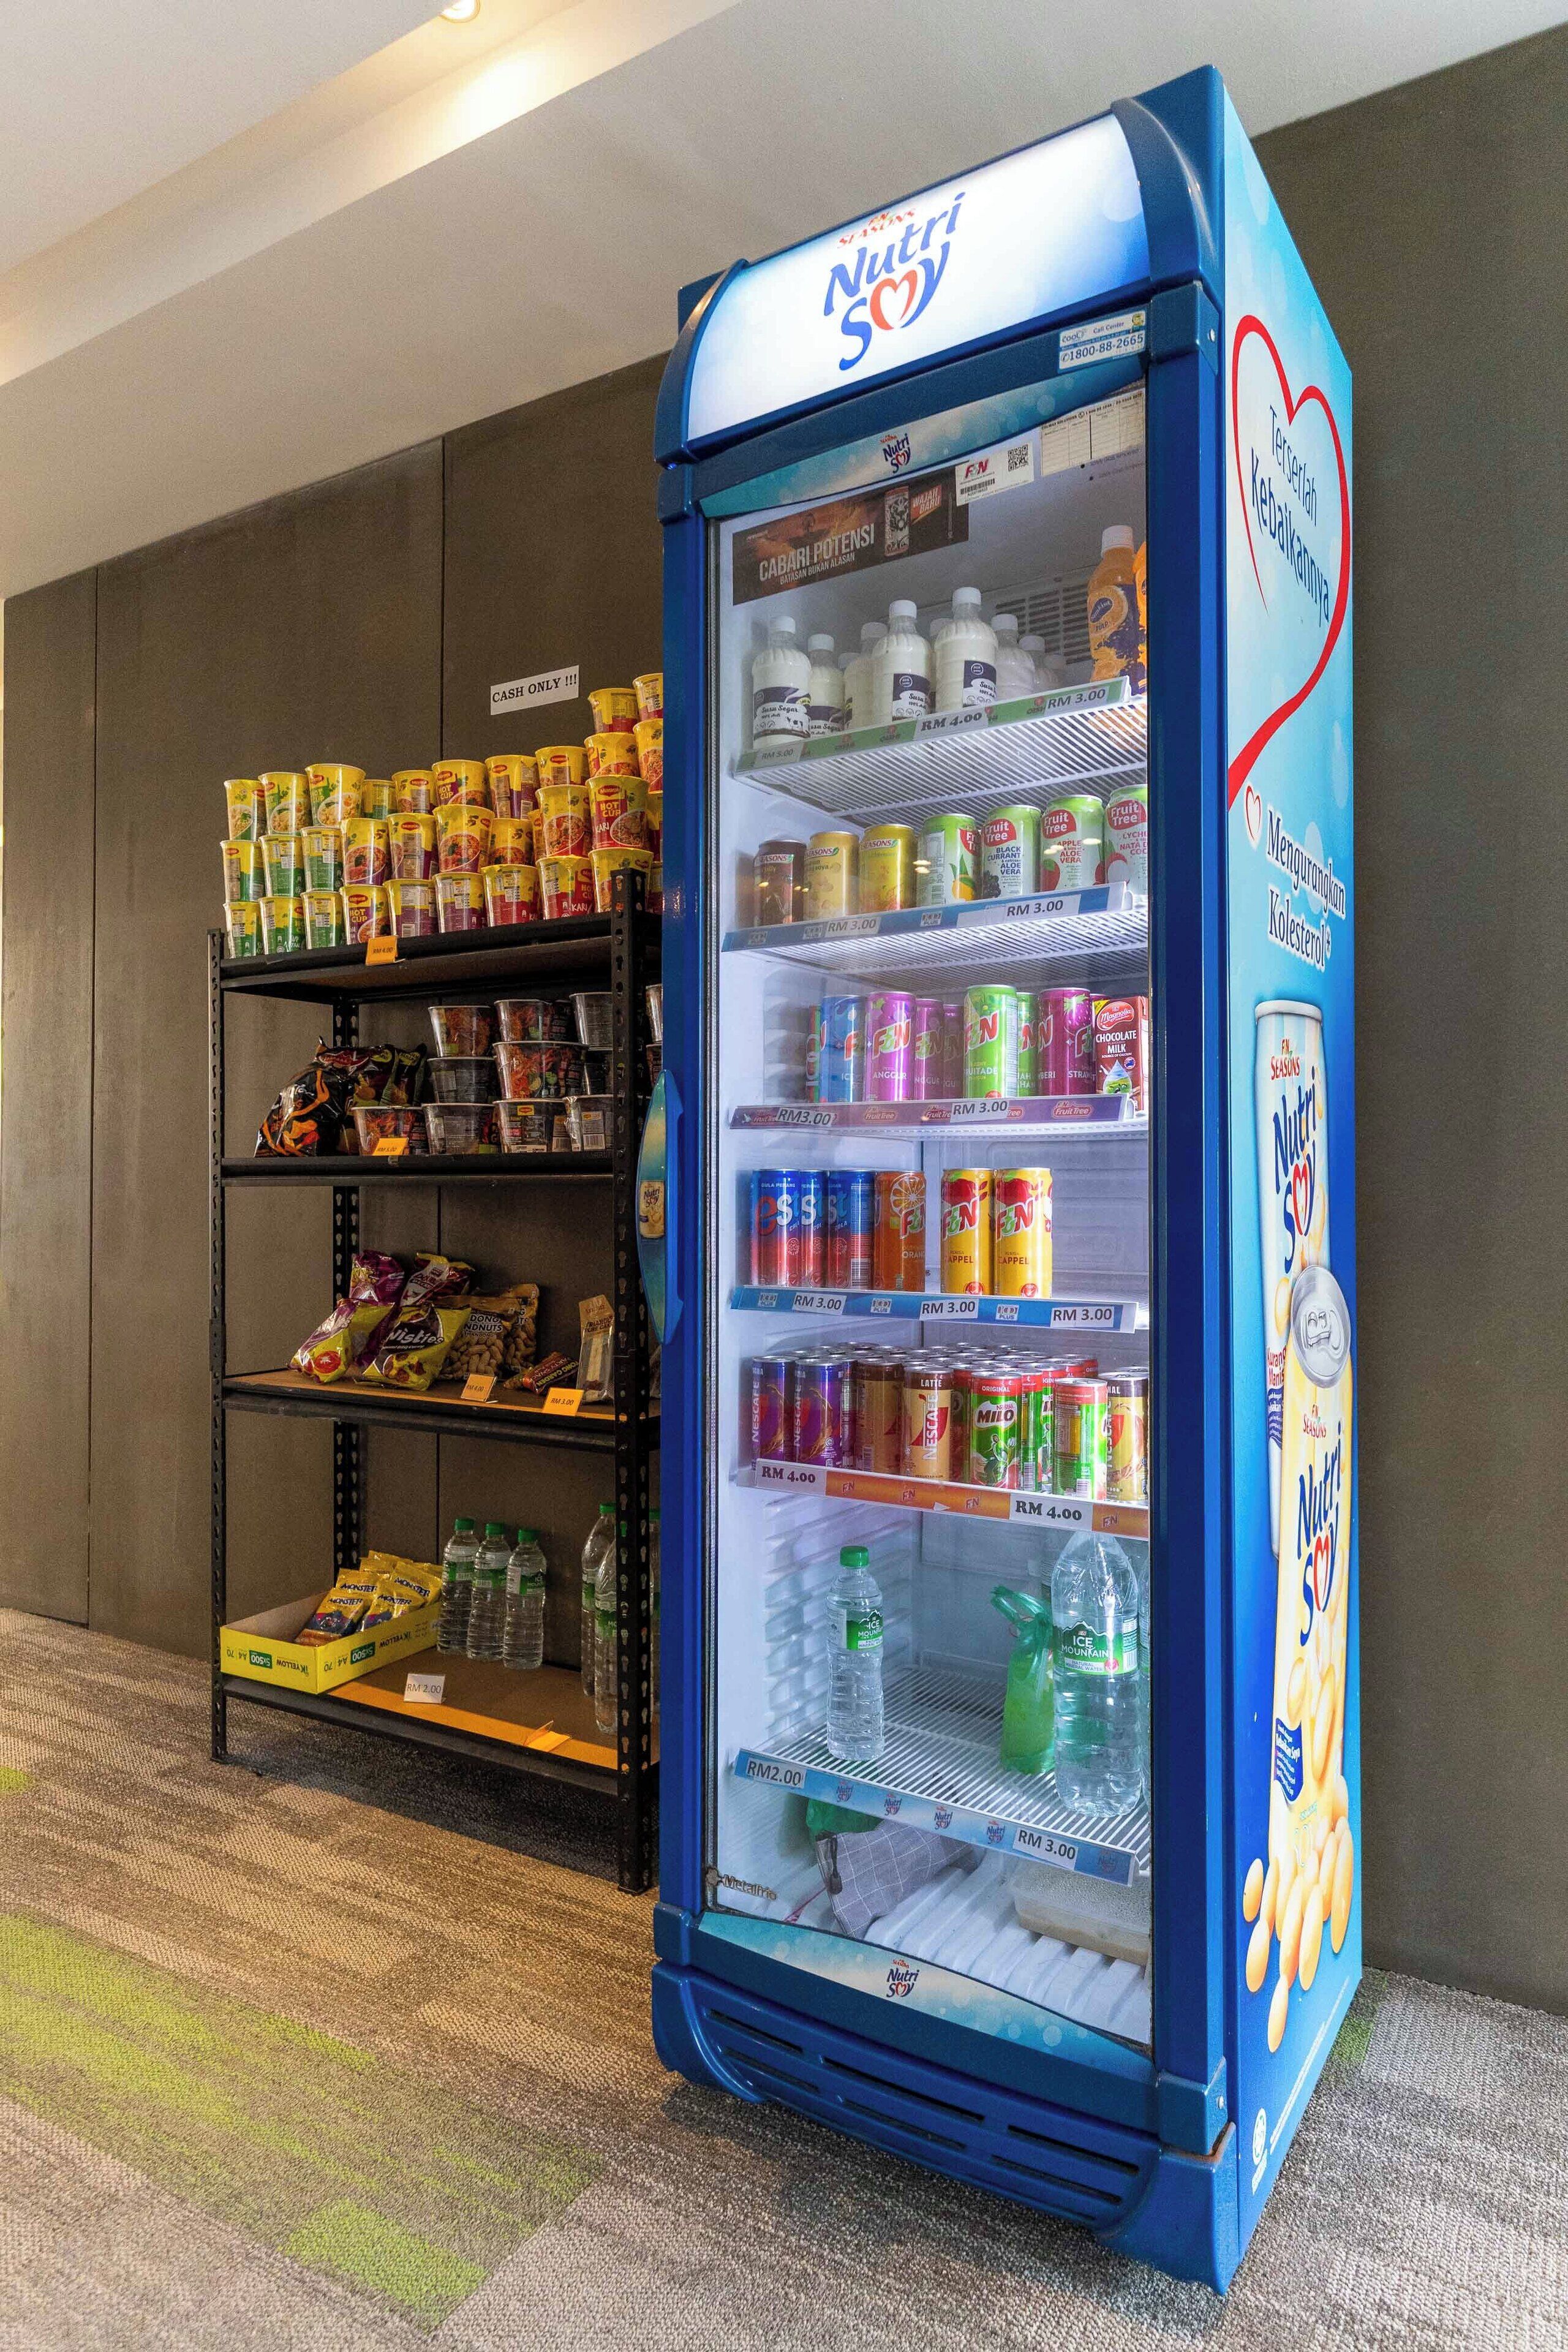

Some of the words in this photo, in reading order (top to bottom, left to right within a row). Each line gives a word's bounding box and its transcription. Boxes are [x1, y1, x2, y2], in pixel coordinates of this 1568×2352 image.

[823, 191, 966, 317] Nutri
[1093, 326, 1104, 334] Call
[1106, 322, 1125, 331] Center
[1070, 333, 1144, 361] 1800-88-2665
[883, 433, 910, 462] Nutri
[1270, 404, 1317, 527] Terserlah
[913, 487, 938, 507] WAJAH
[919, 496, 941, 514] BARU
[1251, 447, 1330, 627] Kebaikannya
[760, 546, 810, 582] CABARI
[813, 523, 875, 564] POTENSI
[780, 567, 807, 585] BATASAN
[809, 562, 829, 576] BUKAN
[831, 554, 855, 570] ALASAN
[492, 686, 524, 703] CASH
[528, 677, 562, 694] ONLY
[565, 674, 577, 686] !!!
[1047, 695, 1072, 709] RM
[1074, 688, 1106, 704] 3.00
[921, 717, 947, 732] RM
[949, 712, 982, 727] 4.00
[602, 809, 621, 818] CUP
[1111, 802, 1139, 817] Fruit
[1044, 812, 1069, 826] Fruit
[1112, 814, 1138, 826] Tree
[985, 821, 1009, 834] Fruit
[1046, 825, 1068, 834] Tree
[986, 832, 1008, 843] Tree
[1120, 842, 1140, 851] NATA
[987, 853, 1021, 861] CURRANT
[1268, 809, 1345, 915] Mengurangkan
[571, 902, 588, 912] KARI
[1007, 903, 1030, 917] RM
[1033, 900, 1063, 914] 3.00
[827, 921, 847, 932] RM
[851, 919, 876, 930] 3.00
[1101, 1008, 1132, 1023] Magnolia
[872, 1019, 911, 1060] F&N
[1095, 1030, 1137, 1043] CHOCOLATE
[1107, 1044, 1126, 1054] MILK
[1271, 1055, 1300, 1080] SEASONS
[873, 1071, 907, 1080] ANGGUR
[953, 1103, 975, 1115] RM
[979, 1101, 1008, 1114] 3.00
[778, 1109, 832, 1125] RM3.00
[1273, 1066, 1316, 1194] Nutri
[942, 1196, 980, 1242] F&N
[995, 1197, 1035, 1243] F&N
[794, 1295, 814, 1307] RM
[816, 1297, 842, 1310] 3.00
[922, 1303, 943, 1314] RM
[947, 1301, 976, 1313] 3.00
[1053, 1309, 1077, 1321] RM
[1080, 1308, 1112, 1321] 3.00
[562, 1360, 579, 1373] TONG
[536, 1366, 563, 1387] GARDEN
[921, 1379, 942, 1388] LATTE
[976, 1408, 1015, 1423] MILO
[1303, 1414, 1327, 1439] SEASONS
[762, 1466, 784, 1480] RM
[787, 1470, 816, 1483] 4.00
[1297, 1420, 1341, 1560] Nutri
[1016, 1500, 1042, 1515] RM
[1047, 1506, 1082, 1521] 4.00
[869, 1619, 880, 1629] ICE
[379, 1635, 403, 1648] YELLOW
[1072, 1635, 1094, 1648] ICE
[227, 1648, 234, 1657] 70
[238, 1651, 247, 1660] A4
[1061, 1645, 1109, 1659] MOUNTAIN
[276, 1659, 300, 1670] YELLOW
[324, 1663, 332, 1672] 70
[337, 1656, 348, 1665] A4
[407, 1684, 421, 1692] RM
[422, 1684, 442, 1694] 2.00
[747, 1758, 802, 1787] RM2.00
[934, 1811, 953, 1821] Nutri
[986, 1824, 1005, 1836] Nutri
[1018, 1829, 1041, 1848] RM
[1044, 1838, 1077, 1860] 3.00
[723, 1874, 777, 1901] Metalfrio
[886, 1967, 920, 1983] Nutri
